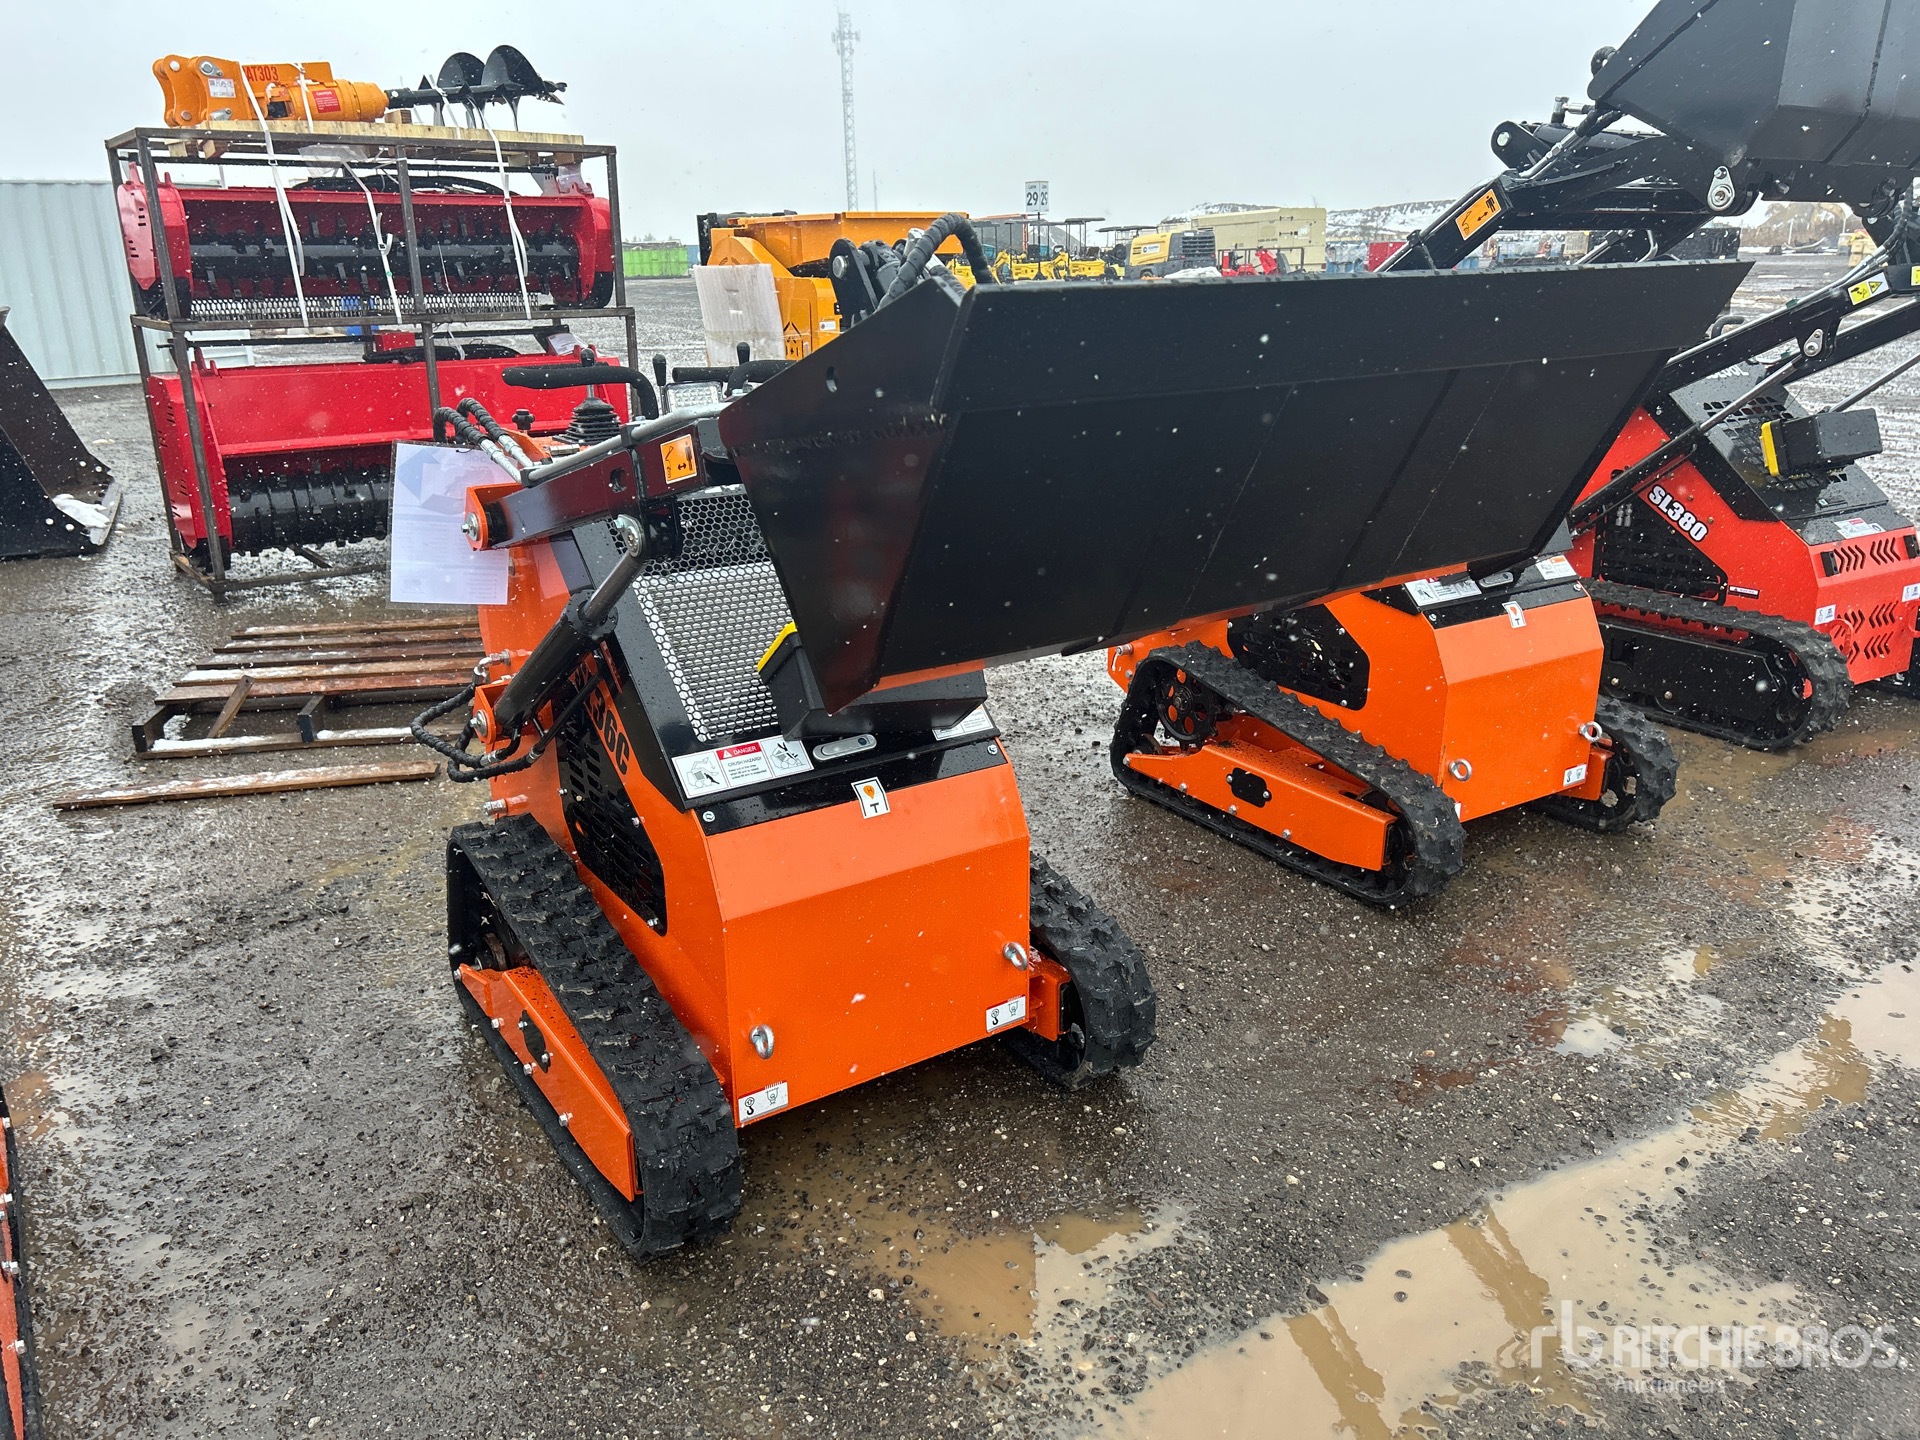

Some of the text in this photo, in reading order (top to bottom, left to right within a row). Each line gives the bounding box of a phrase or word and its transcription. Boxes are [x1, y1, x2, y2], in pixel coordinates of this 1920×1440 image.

[1026, 191, 1039, 206] 29
[1648, 484, 1708, 542] SL380
[733, 745, 757, 756] DANGER
[870, 802, 879, 813] T
